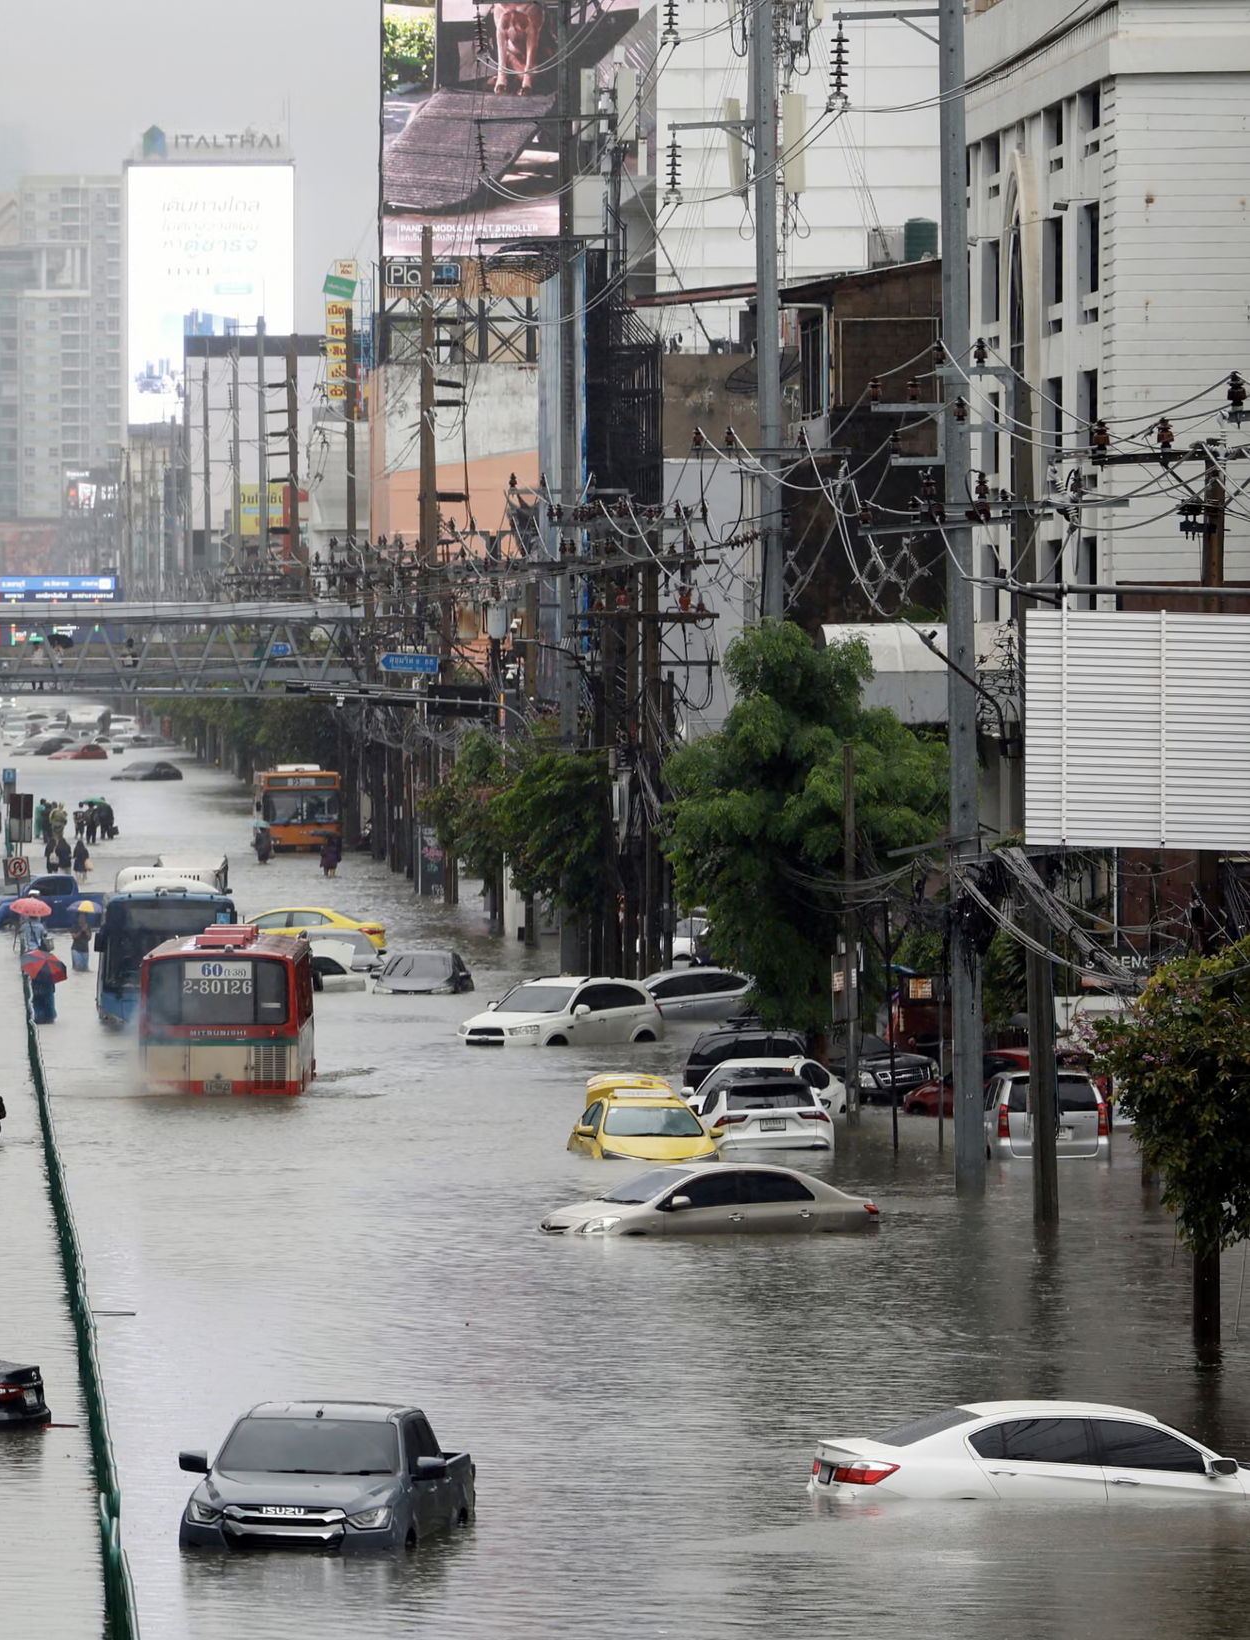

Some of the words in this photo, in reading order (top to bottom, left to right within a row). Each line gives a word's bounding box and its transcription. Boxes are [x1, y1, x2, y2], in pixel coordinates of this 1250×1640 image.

[174, 133, 281, 149] ITALTHAI
[432, 224, 475, 233] MODULAR
[477, 224, 493, 232] PET
[495, 223, 539, 232] STROLLER
[201, 963, 224, 977] 60
[183, 979, 253, 995] 2-80126
[262, 1506, 305, 1515] ISUZU
